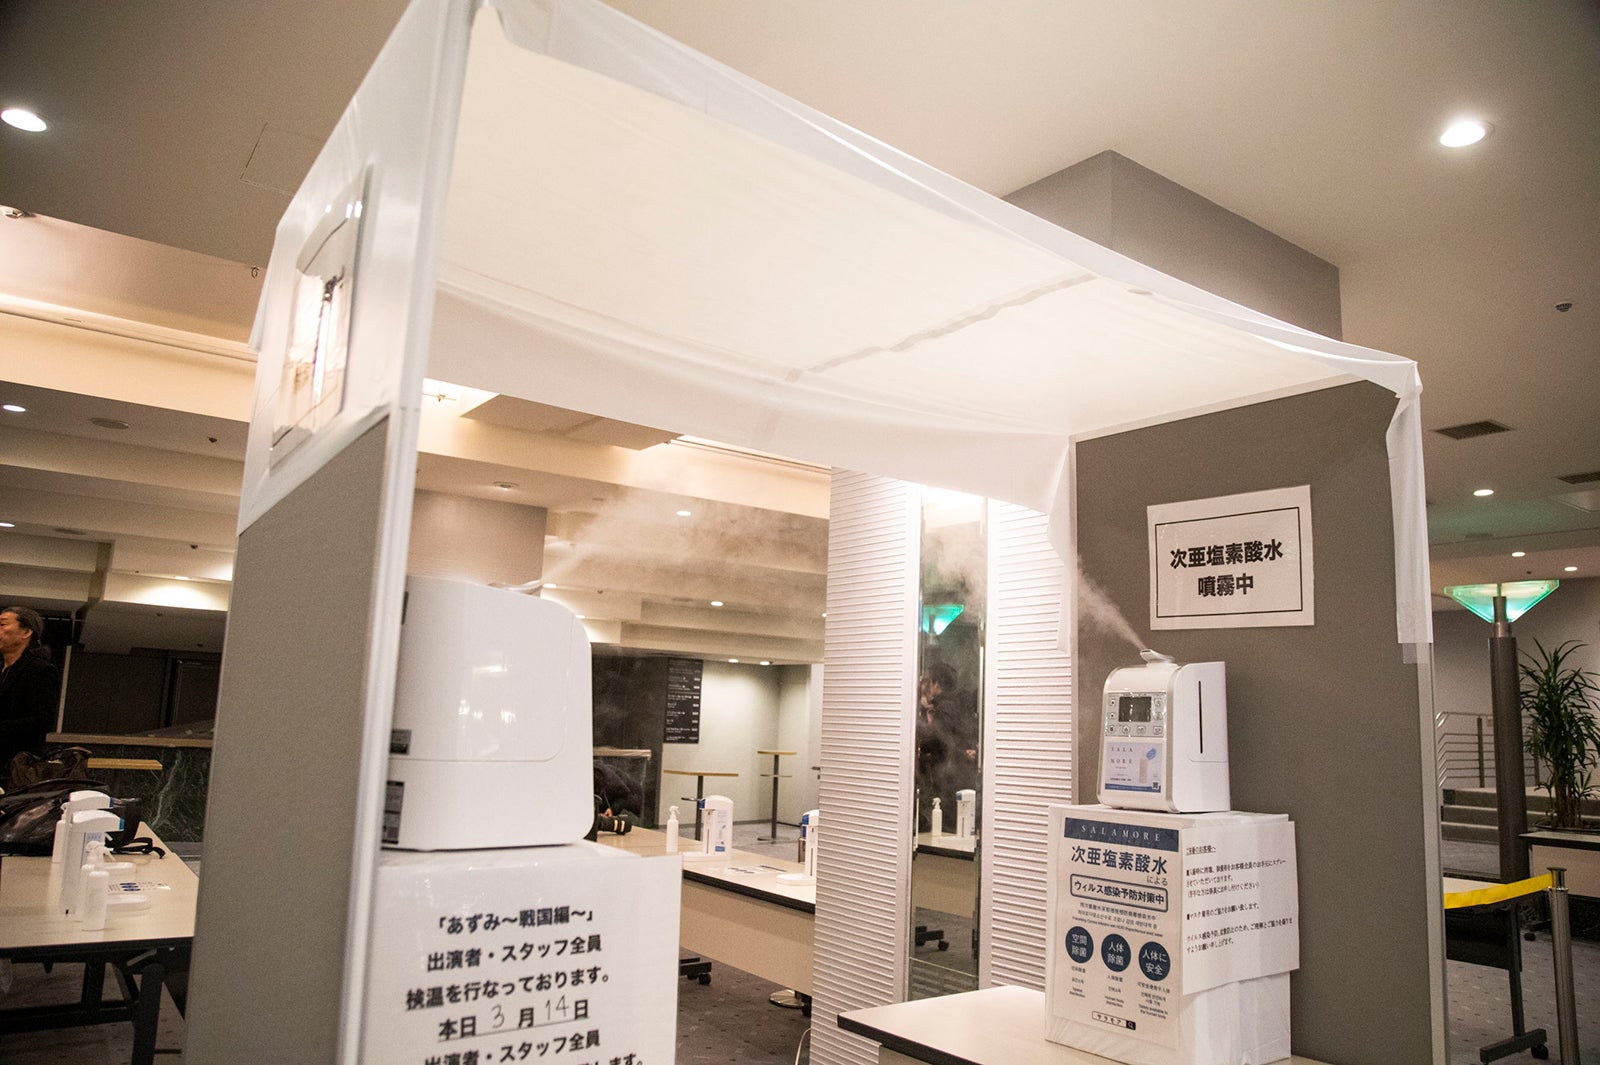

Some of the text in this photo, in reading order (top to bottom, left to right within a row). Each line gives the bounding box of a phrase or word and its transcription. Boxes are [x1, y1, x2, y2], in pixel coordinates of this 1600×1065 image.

[1170, 539, 1283, 569] 次亜塩素酸水
[1198, 573, 1254, 597] 噴霧中
[1080, 825, 1161, 842] SALAMORE
[1071, 845, 1168, 875] 次亜塩素酸水
[1146, 875, 1168, 887] による
[1074, 880, 1165, 904] ウィルス感染予防対策中
[427, 934, 602, 972] 出演者・スタッフ全員
[1071, 945, 1087, 958] 除菌
[1108, 941, 1125, 953] 人体
[1142, 949, 1167, 963] 人体に
[1107, 953, 1124, 966] 除菌
[1145, 962, 1163, 976] 安全
[405, 966, 609, 1010] 検温を行なっております。
[438, 995, 590, 1041] 本日 3 月 14 日
